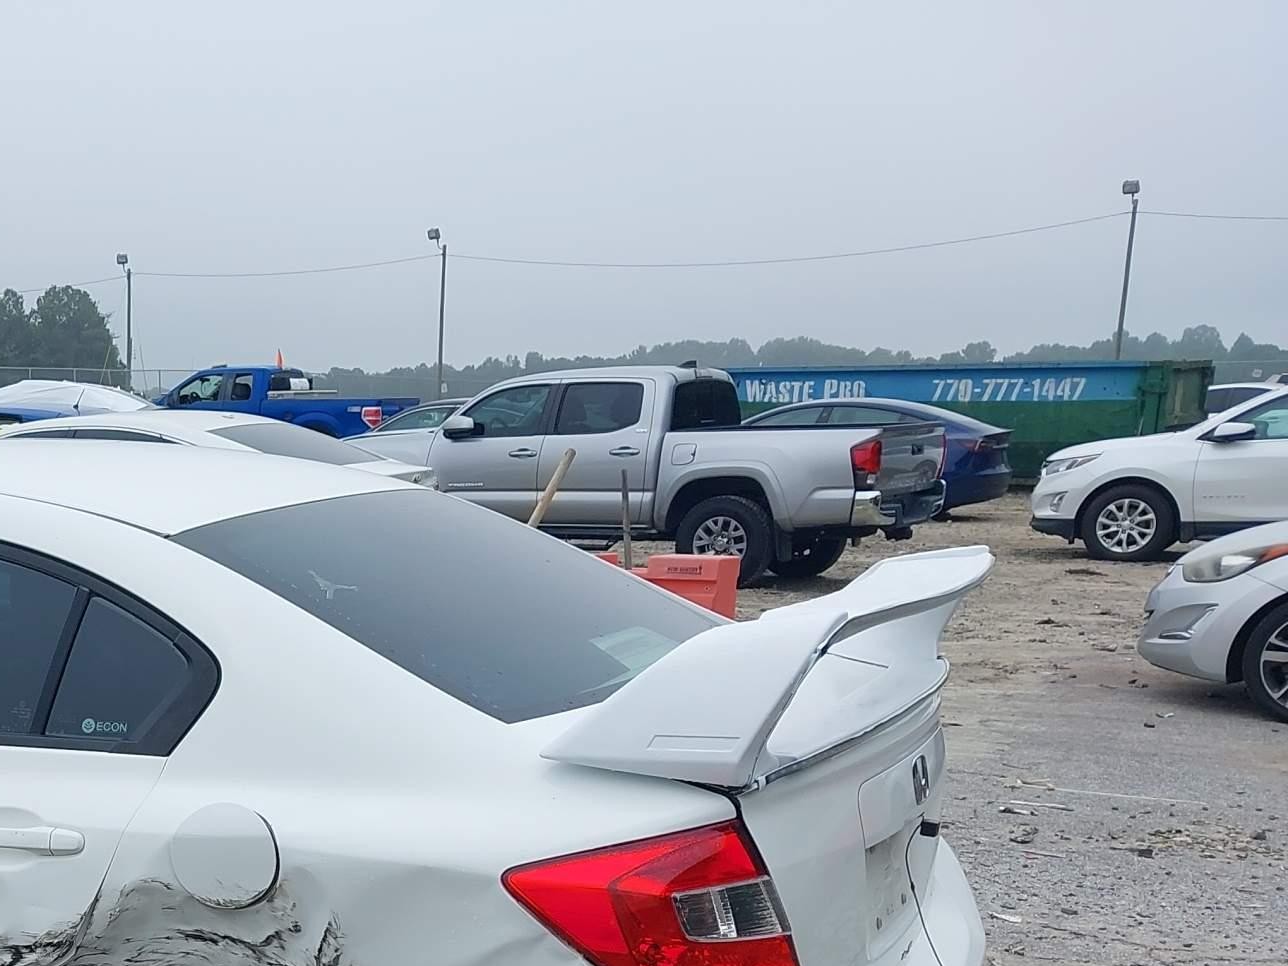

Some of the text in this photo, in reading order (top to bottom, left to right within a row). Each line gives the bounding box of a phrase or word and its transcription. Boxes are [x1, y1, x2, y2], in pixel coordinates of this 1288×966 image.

[745, 379, 815, 403] WASTE
[932, 378, 1087, 402] 770-777-1447
[96, 721, 128, 732] ECON
